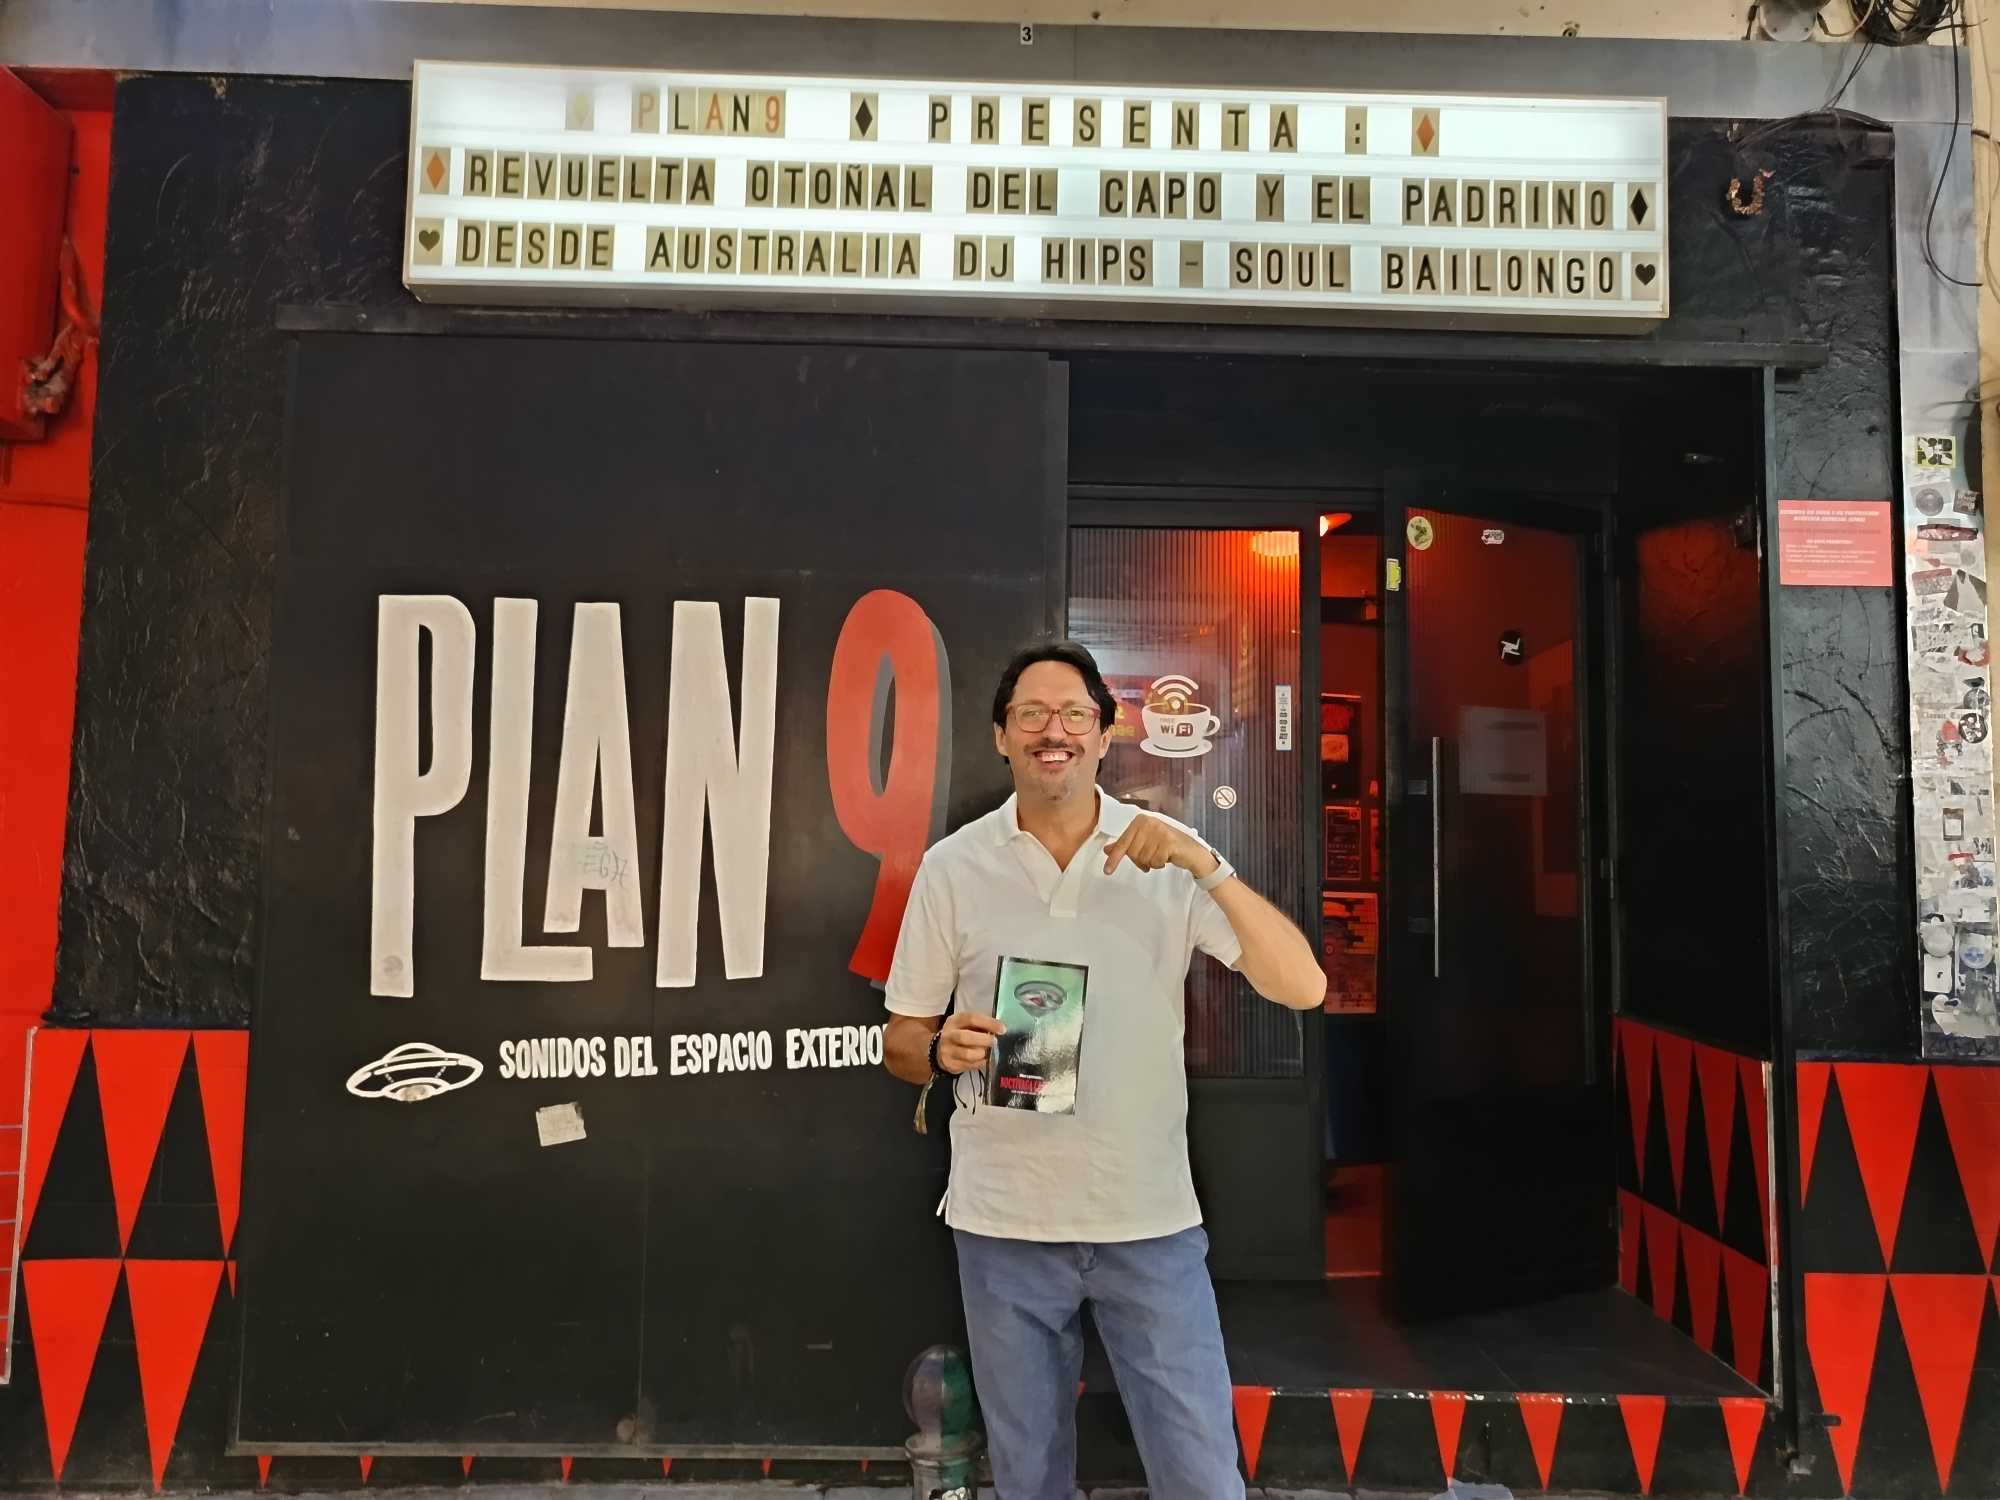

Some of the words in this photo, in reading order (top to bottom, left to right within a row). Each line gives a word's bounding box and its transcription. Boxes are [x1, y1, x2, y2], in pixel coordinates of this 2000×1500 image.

[1022, 26, 1032, 42] 3
[930, 102, 1295, 148] PRESENTA
[470, 155, 711, 201] REVUELTA
[751, 163, 927, 207] OTOÑAL
[973, 171, 1051, 211] DEL
[1105, 178, 1217, 215] CAPO
[1263, 182, 1280, 217] Y
[1318, 183, 1365, 219] EL
[1405, 185, 1607, 228] PADRINO
[462, 225, 609, 267] DESDE
[651, 231, 917, 275] AUSTRALIA
[959, 241, 1009, 278] DJ
[1046, 243, 1147, 280] HIPS
[1235, 247, 1345, 288] SOUL
[1387, 252, 1614, 294] BAILONGO
[370, 594, 781, 998] PLAN
[826, 588, 950, 990] 9
[499, 1036, 607, 1079] SONIDOS
[613, 1035, 658, 1078] DEL
[669, 1030, 773, 1076] ESPACIO
[785, 1024, 888, 1070] EXTERIO
